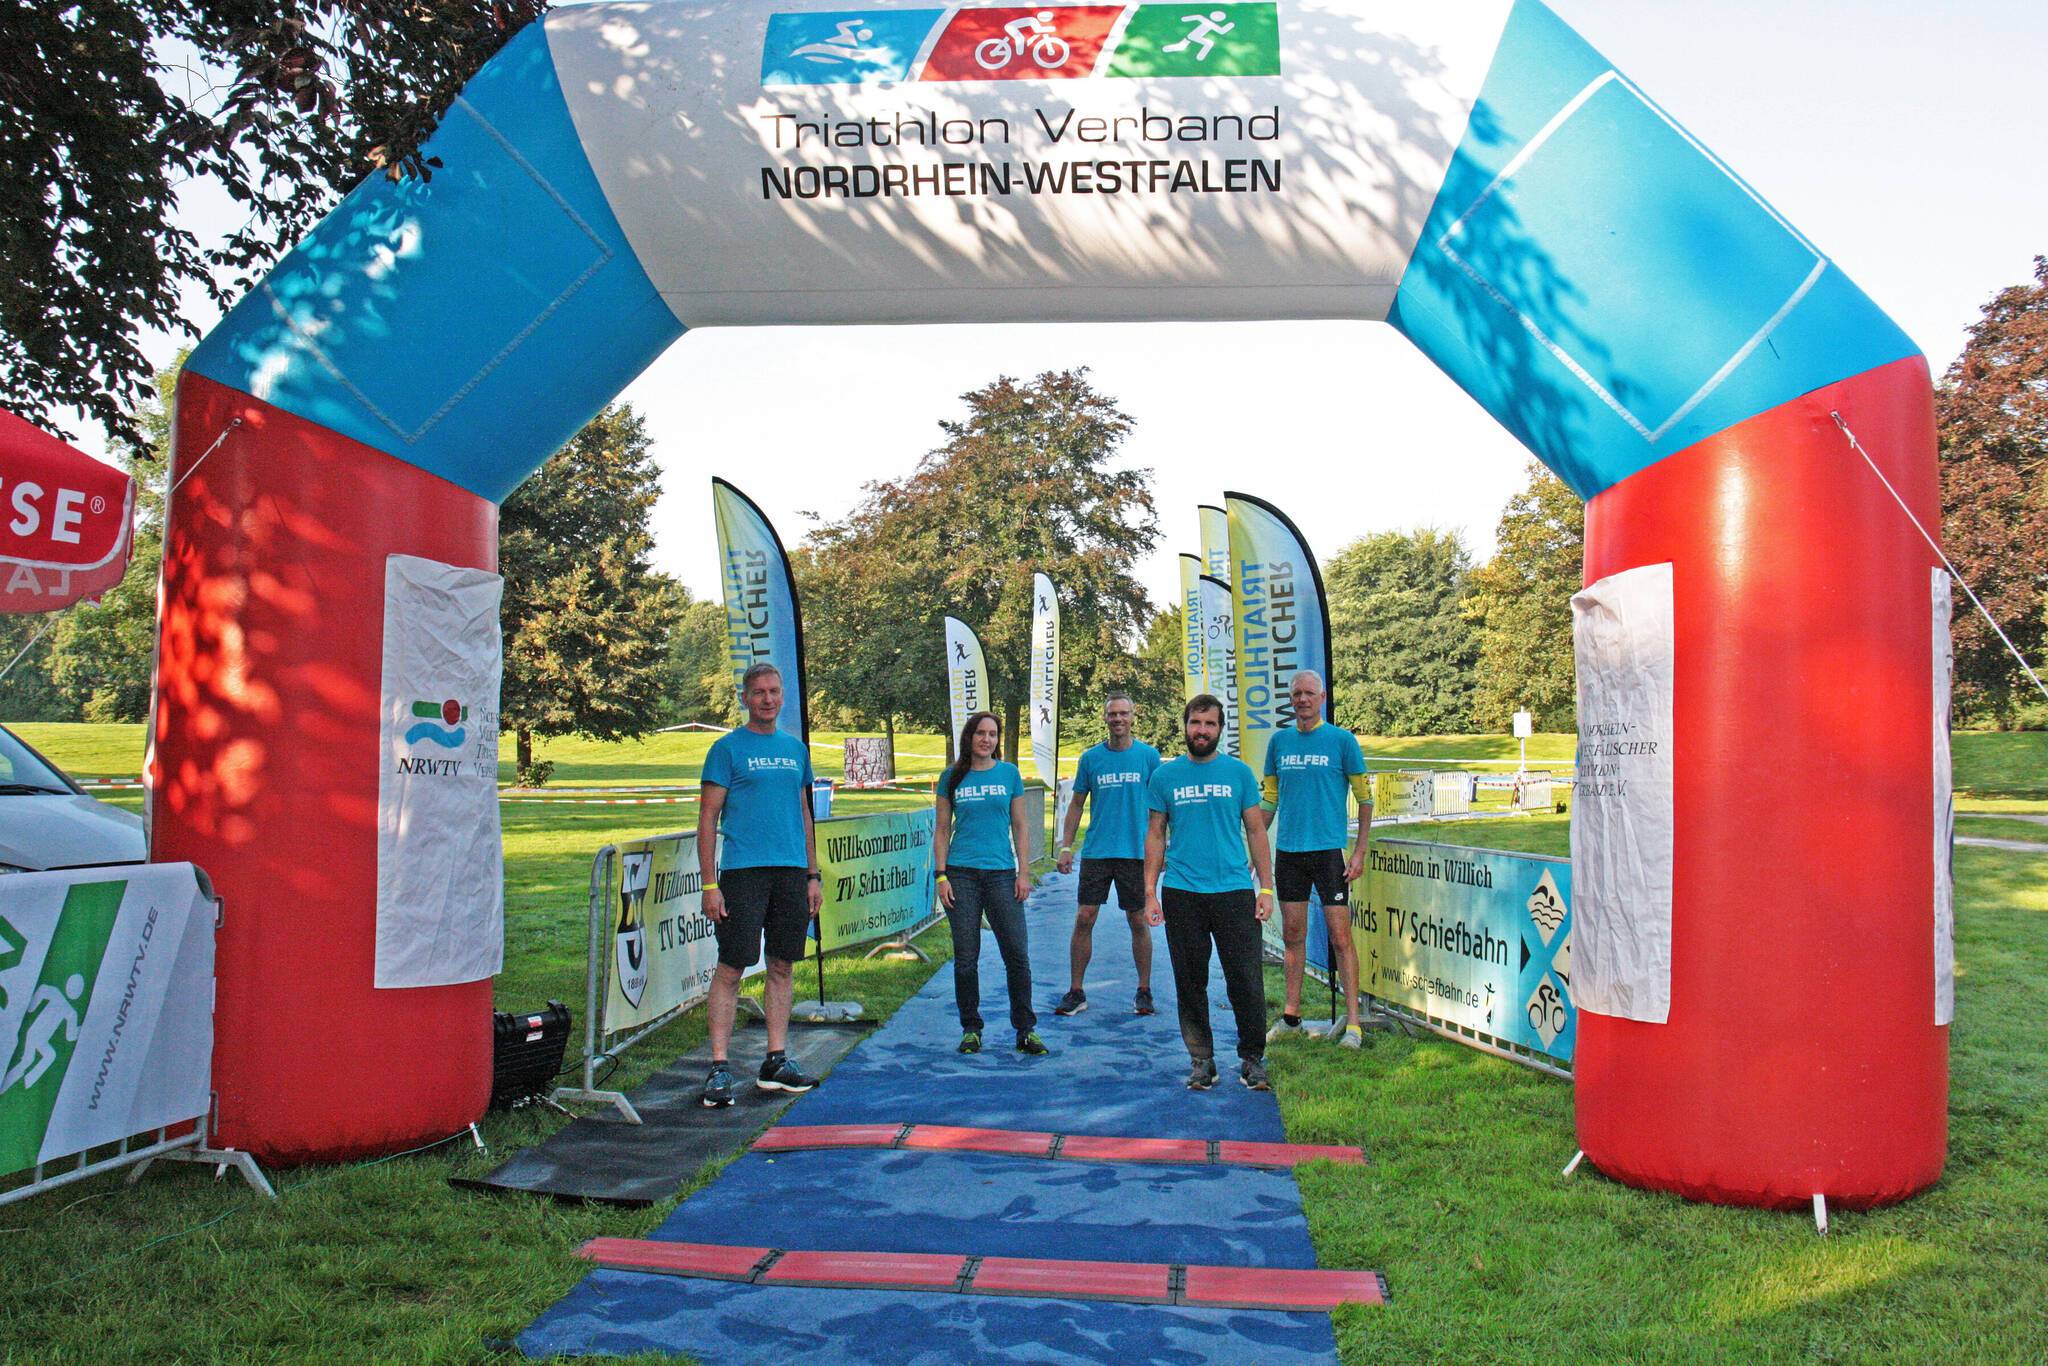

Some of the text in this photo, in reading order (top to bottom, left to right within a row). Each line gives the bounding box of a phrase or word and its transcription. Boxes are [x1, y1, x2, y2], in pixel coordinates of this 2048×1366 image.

[760, 105, 1279, 149] Triathlon Verband
[761, 159, 1281, 200] NORDRHEIN-WESTFALEN
[397, 757, 462, 777] NRWTV
[747, 757, 798, 768] HELFER
[1280, 754, 1329, 767] HELFER
[1097, 771, 1141, 785] HELFER
[955, 785, 1007, 800] HELFER
[1173, 784, 1232, 801] HELFER
[827, 832, 907, 863] Willkommen
[1371, 850, 1493, 889] Triathlon in Willich
[836, 876, 856, 902] TV
[658, 919, 674, 952] TV
[1386, 906, 1406, 940] TV
[1410, 911, 1508, 967] Schiefbahn
